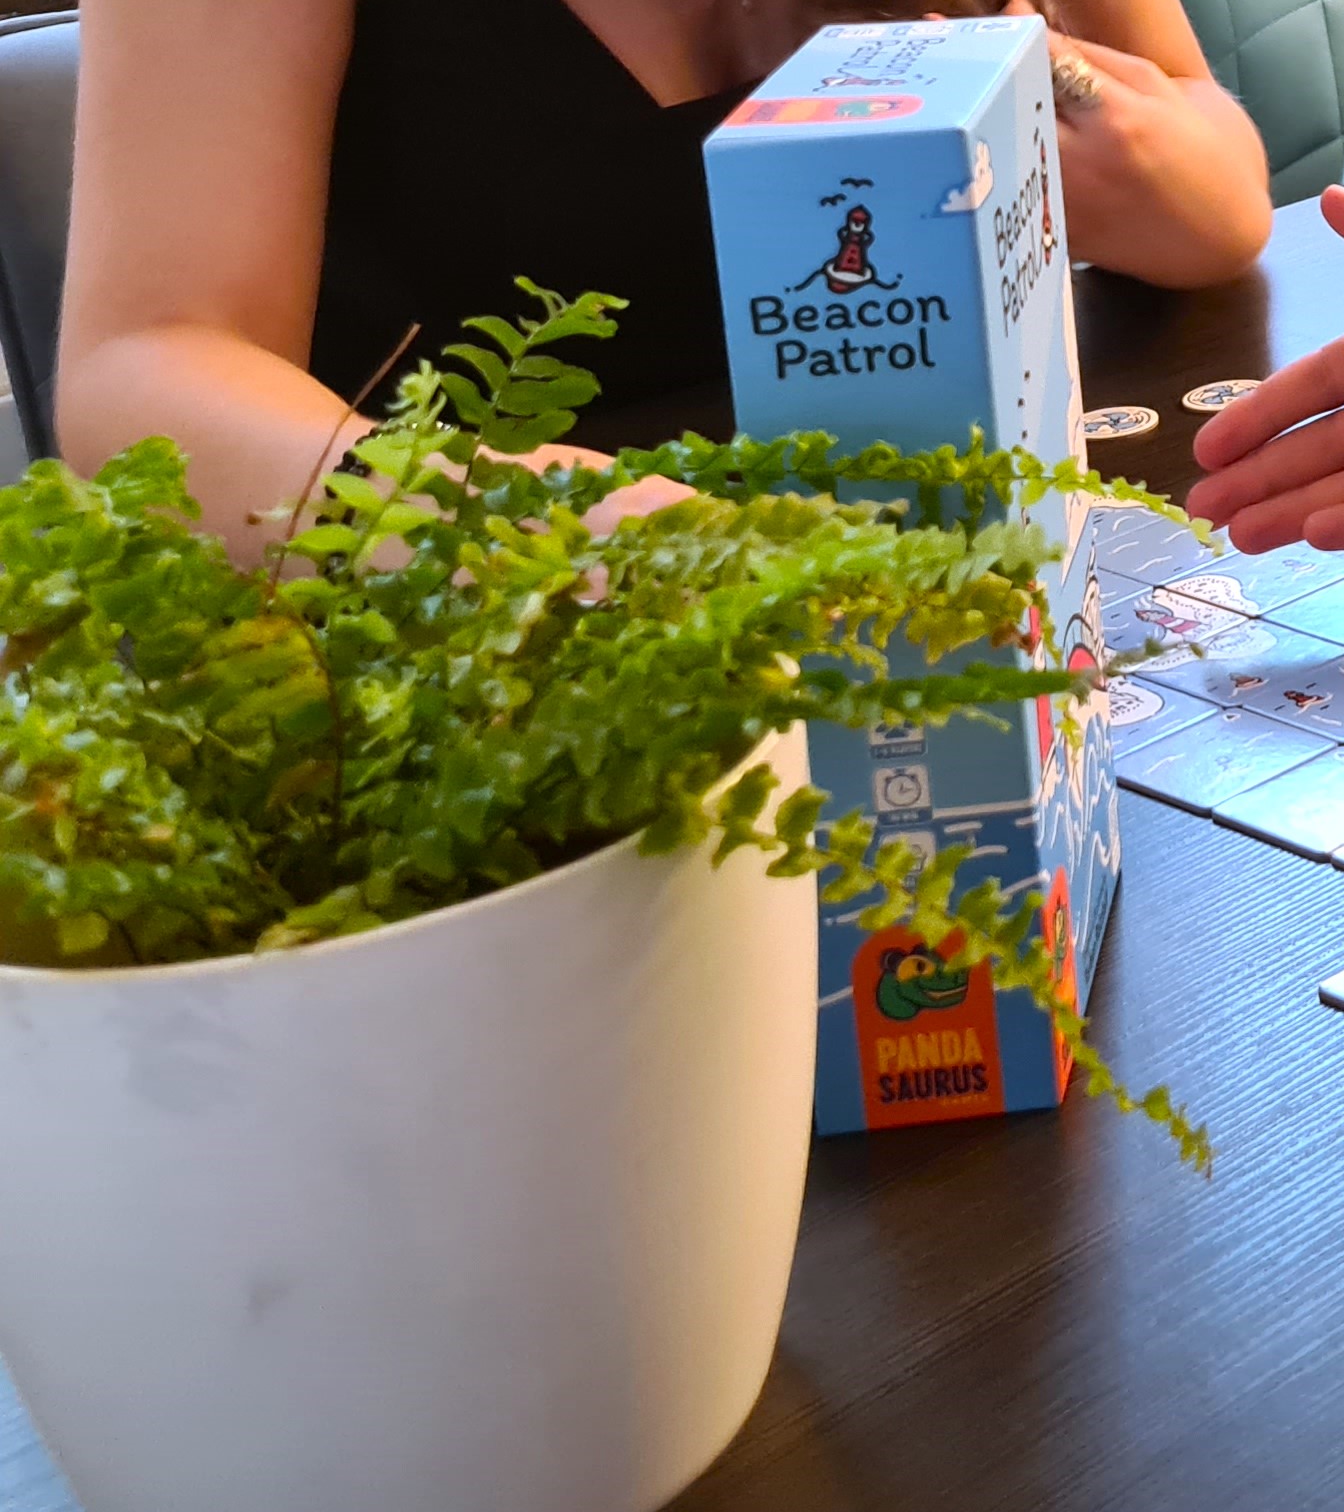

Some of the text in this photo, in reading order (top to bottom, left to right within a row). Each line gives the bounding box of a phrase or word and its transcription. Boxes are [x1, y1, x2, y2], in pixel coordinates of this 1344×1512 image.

[993, 167, 1041, 270] Beacon
[1000, 235, 1043, 337] Patrol
[749, 294, 951, 336] Beacon
[775, 327, 936, 380] Patrol
[876, 1027, 984, 1074] PANDA
[878, 1063, 989, 1105] SAURUS
